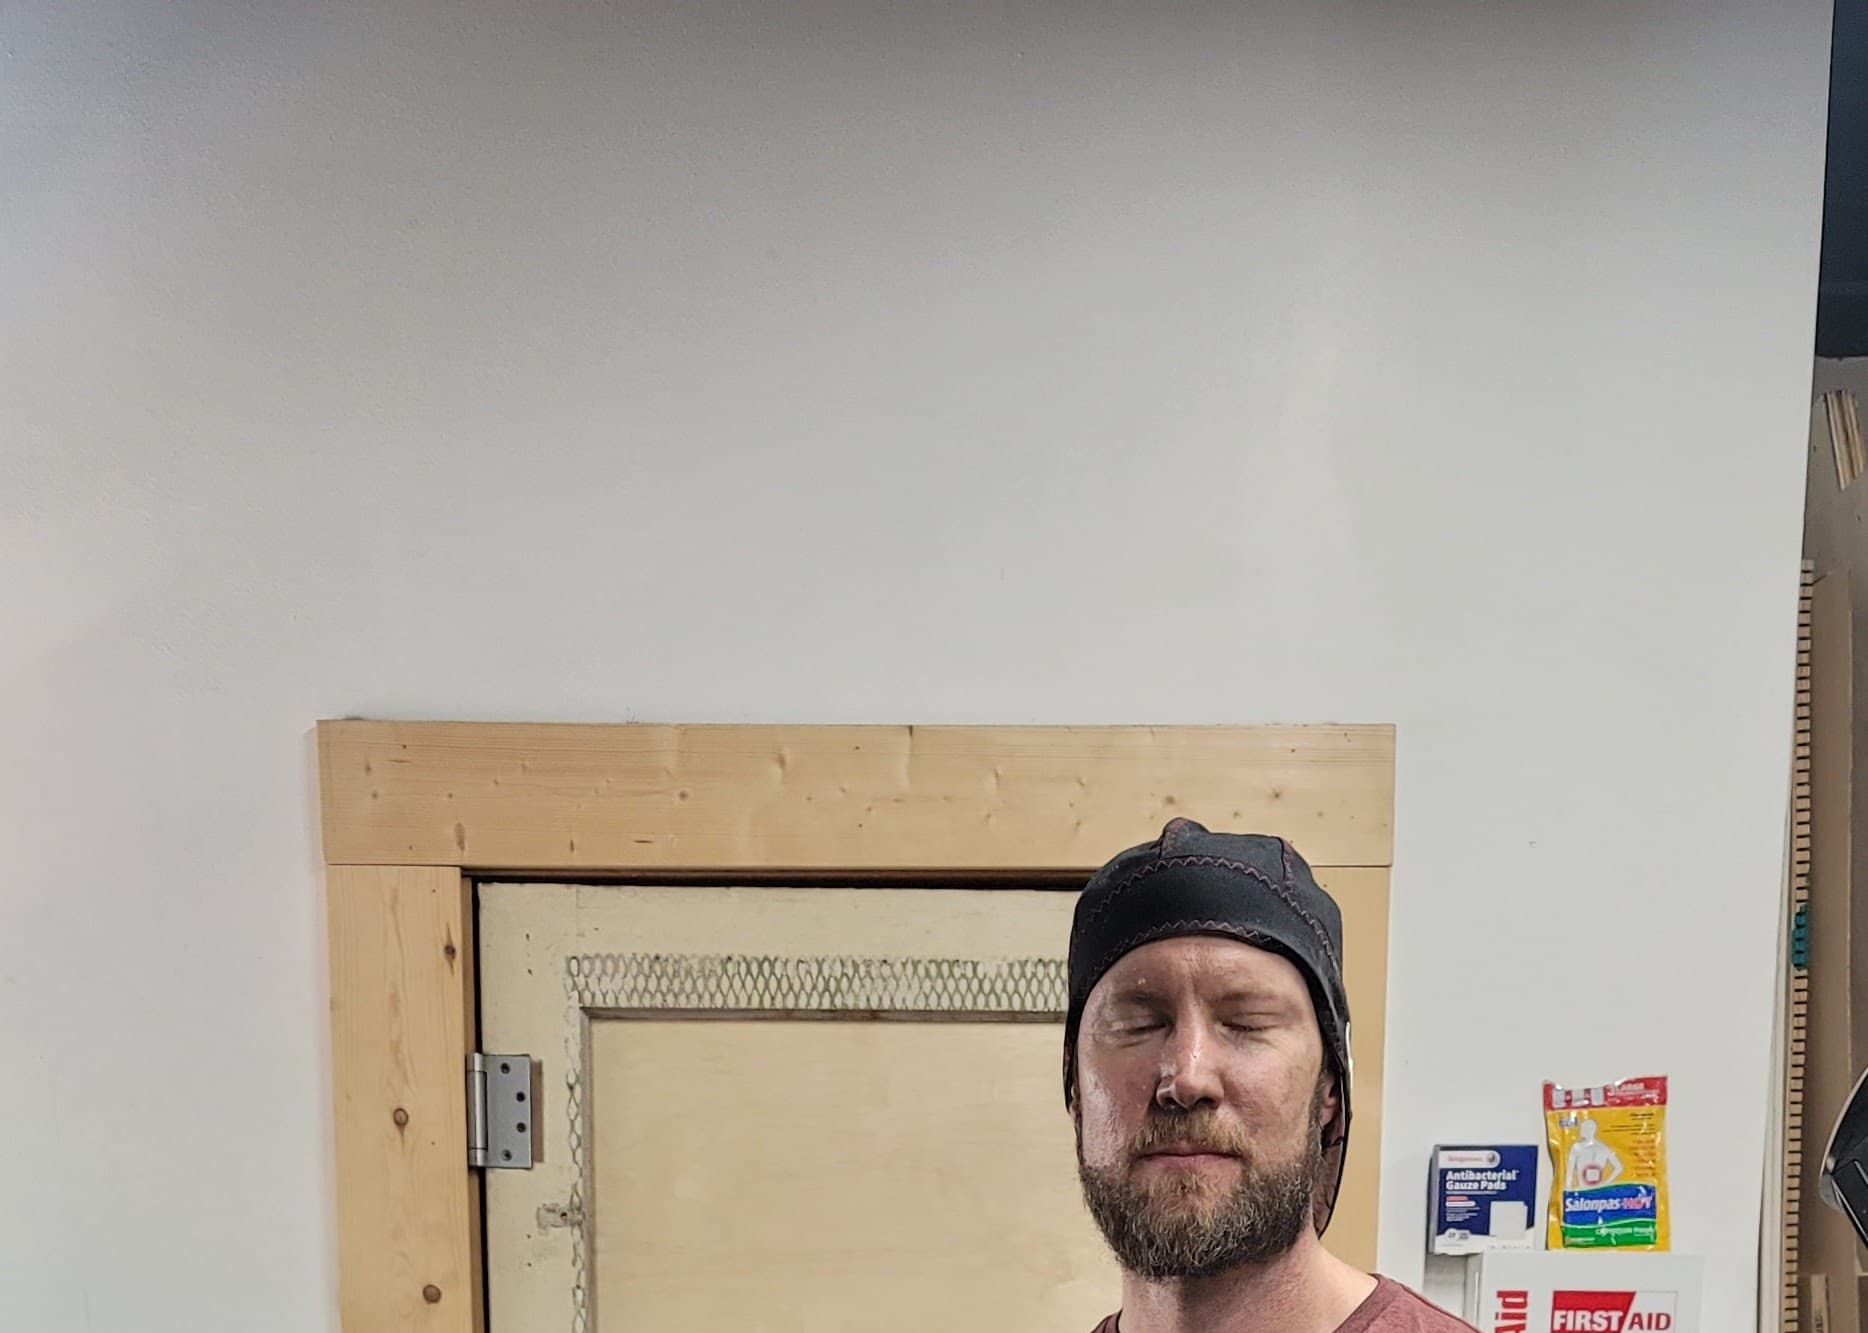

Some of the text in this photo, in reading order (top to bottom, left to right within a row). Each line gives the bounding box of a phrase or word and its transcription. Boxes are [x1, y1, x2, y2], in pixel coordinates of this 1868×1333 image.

[1446, 1170, 1516, 1180] Antibacterial
[1446, 1181, 1507, 1190] Gauze Pads
[1553, 1310, 1671, 1331] FIRST AID
